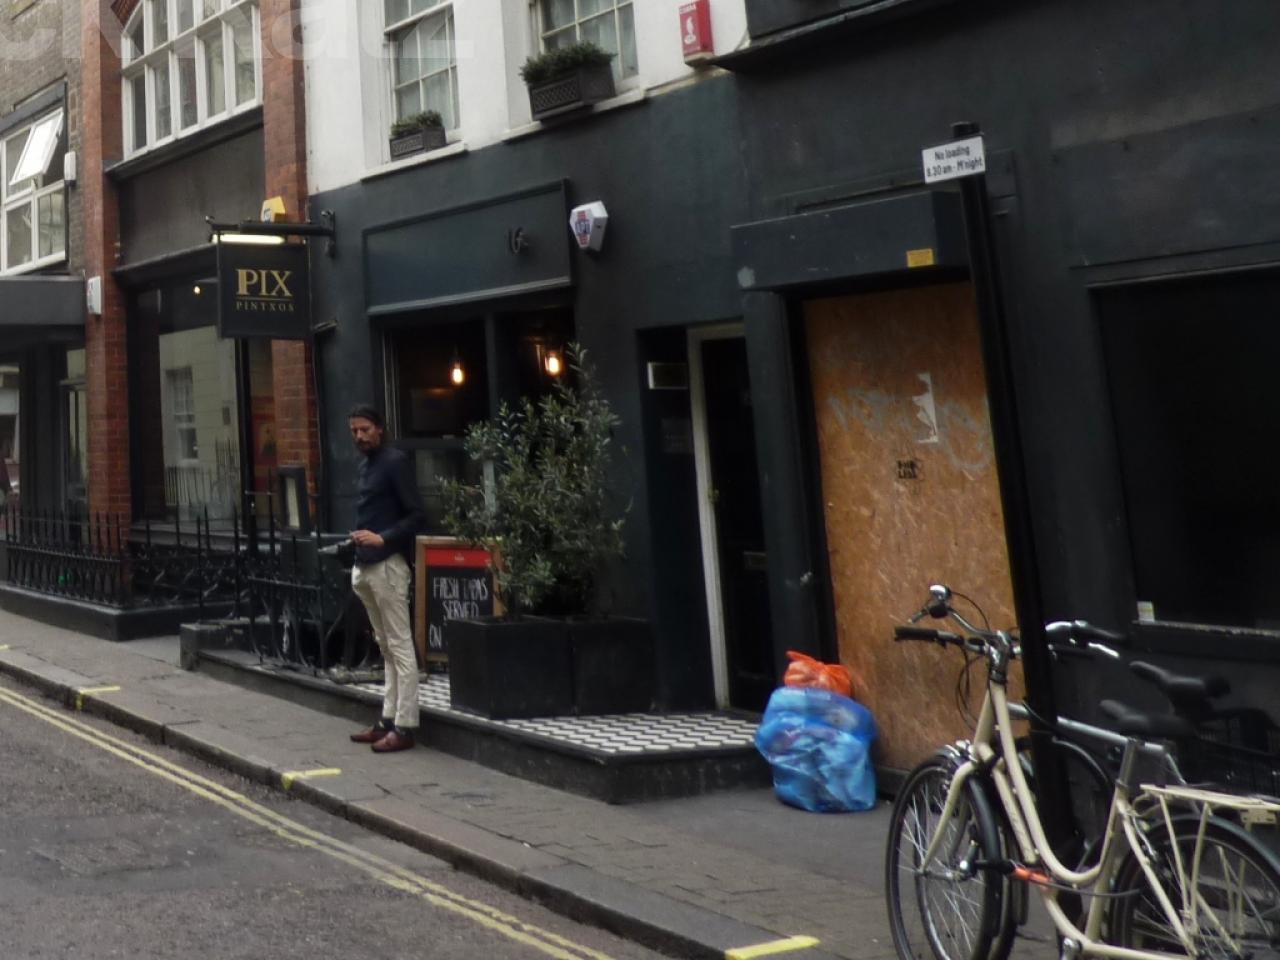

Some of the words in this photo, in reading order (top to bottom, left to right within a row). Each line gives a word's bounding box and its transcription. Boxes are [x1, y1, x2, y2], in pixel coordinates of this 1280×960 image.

[934, 150, 945, 160] No
[945, 145, 970, 159] loading
[235, 269, 292, 297] PIX
